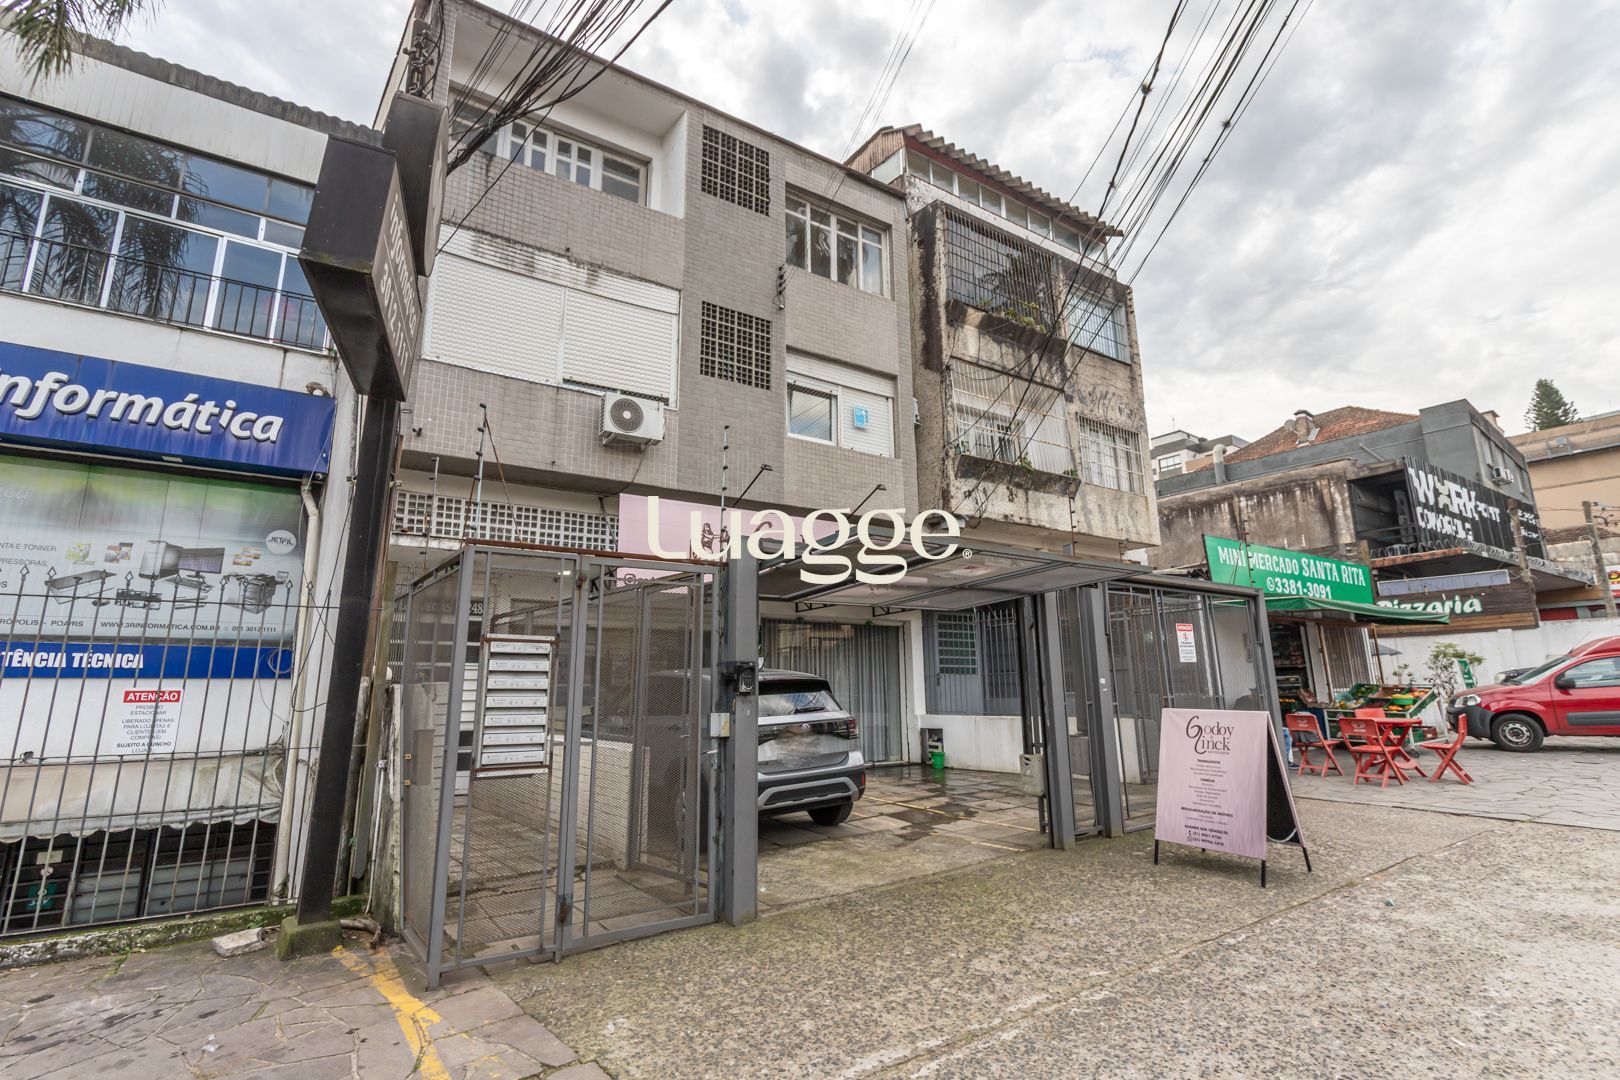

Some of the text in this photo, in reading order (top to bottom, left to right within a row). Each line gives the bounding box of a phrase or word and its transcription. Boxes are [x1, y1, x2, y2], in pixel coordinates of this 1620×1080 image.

[0, 368, 284, 444] nformática
[24, 543, 57, 552] TONNER
[1217, 546, 1367, 587] MINI MERCADO SANTA RITA
[1275, 577, 1332, 600] 3381-3091
[72, 649, 144, 669] TÉCNICA
